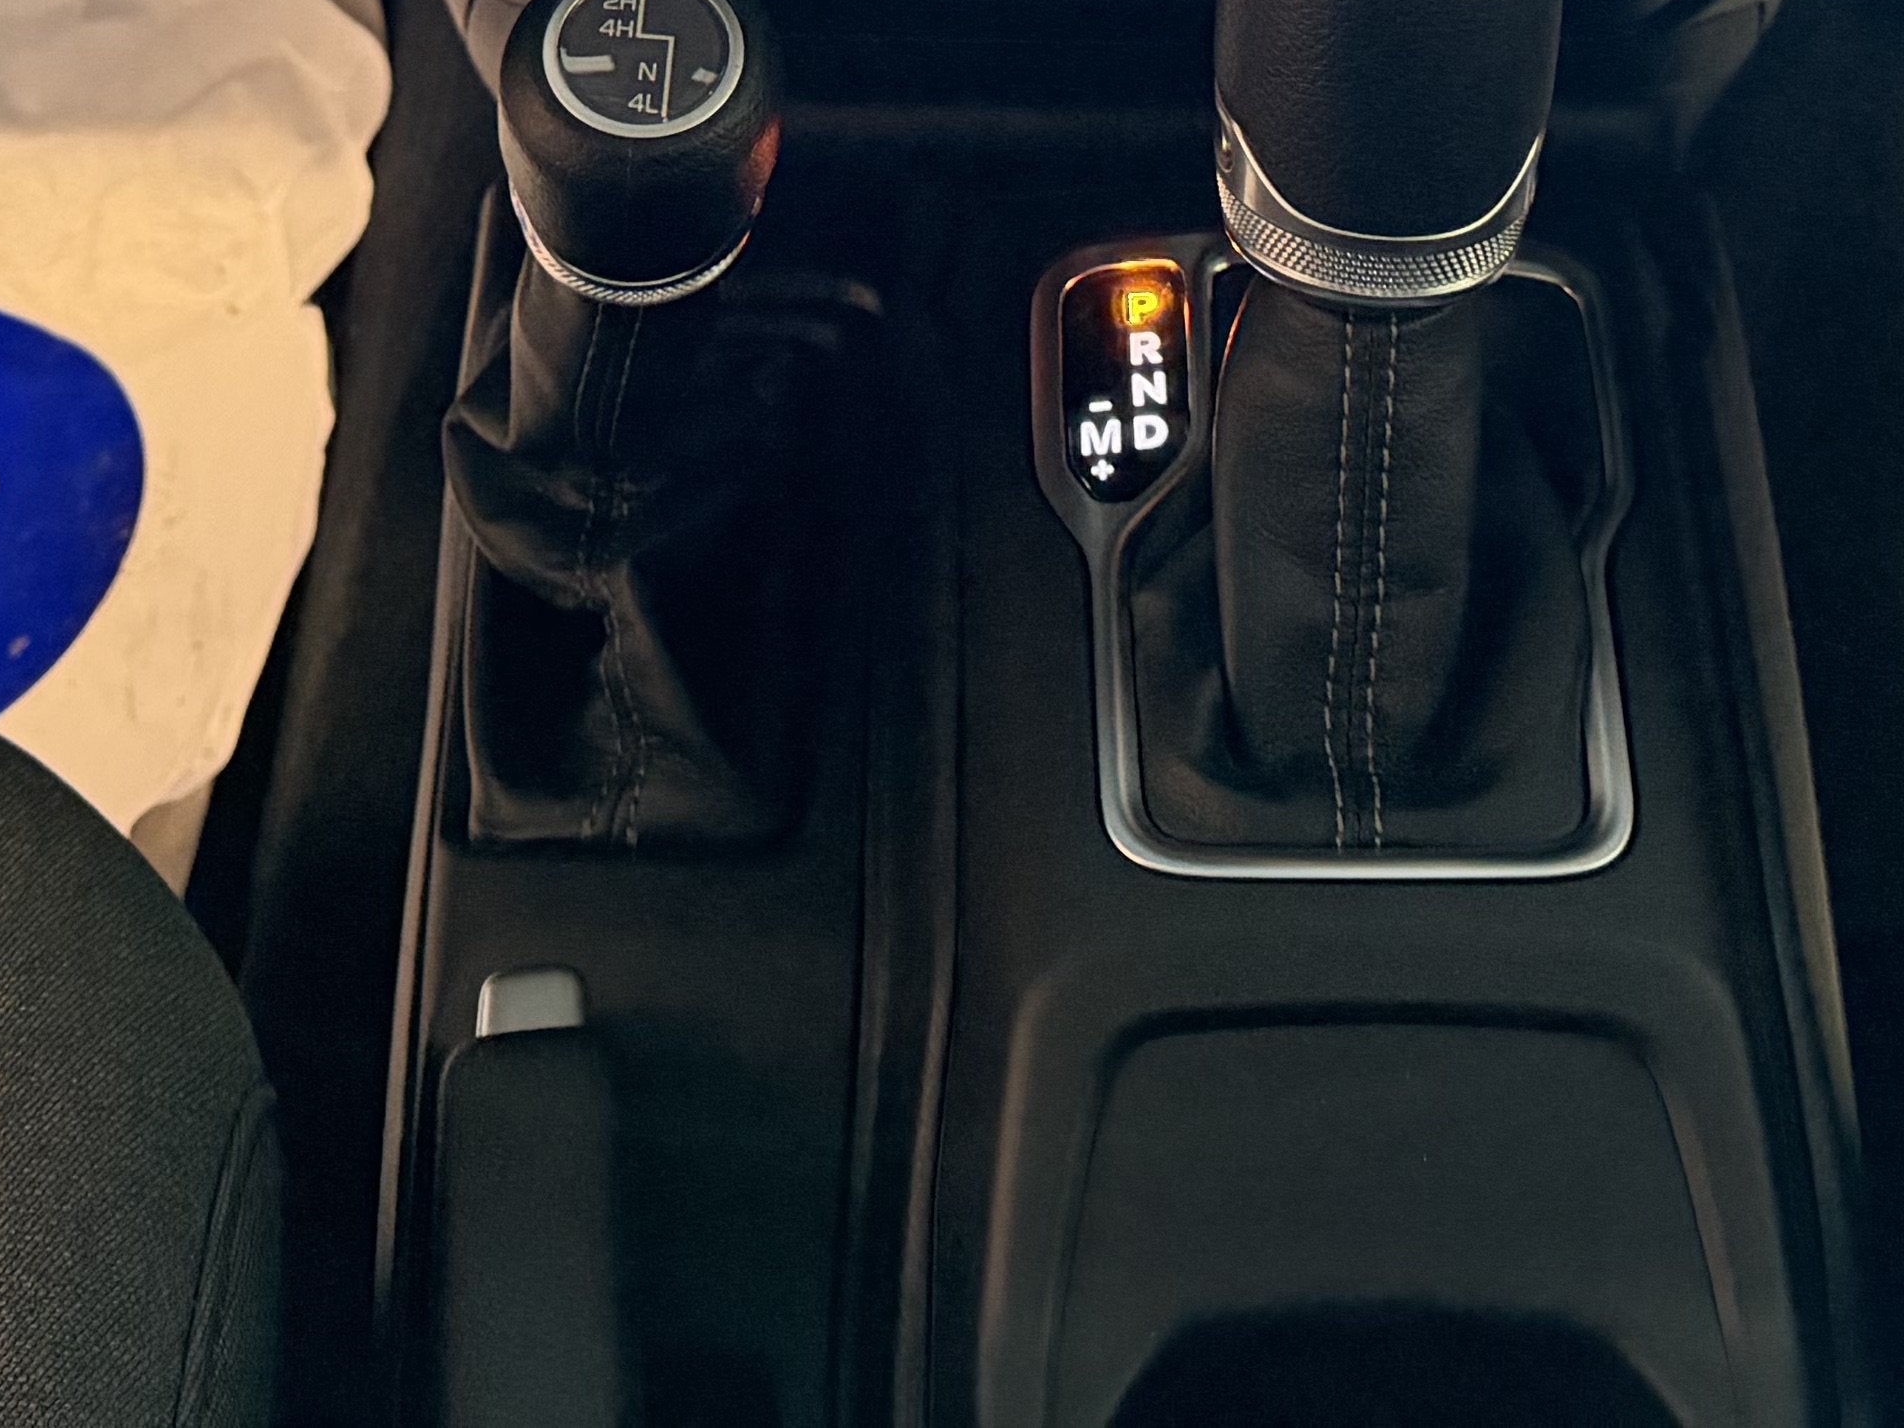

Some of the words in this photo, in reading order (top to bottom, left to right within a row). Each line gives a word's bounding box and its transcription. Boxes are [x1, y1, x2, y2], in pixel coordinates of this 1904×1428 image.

[598, 18, 635, 39] 4H
[637, 61, 658, 83] N
[627, 93, 659, 115] 4L
[1126, 291, 1160, 327] P
[1128, 331, 1163, 366] R
[1131, 370, 1169, 408] N
[1079, 418, 1123, 457] M
[1133, 414, 1170, 451] D
